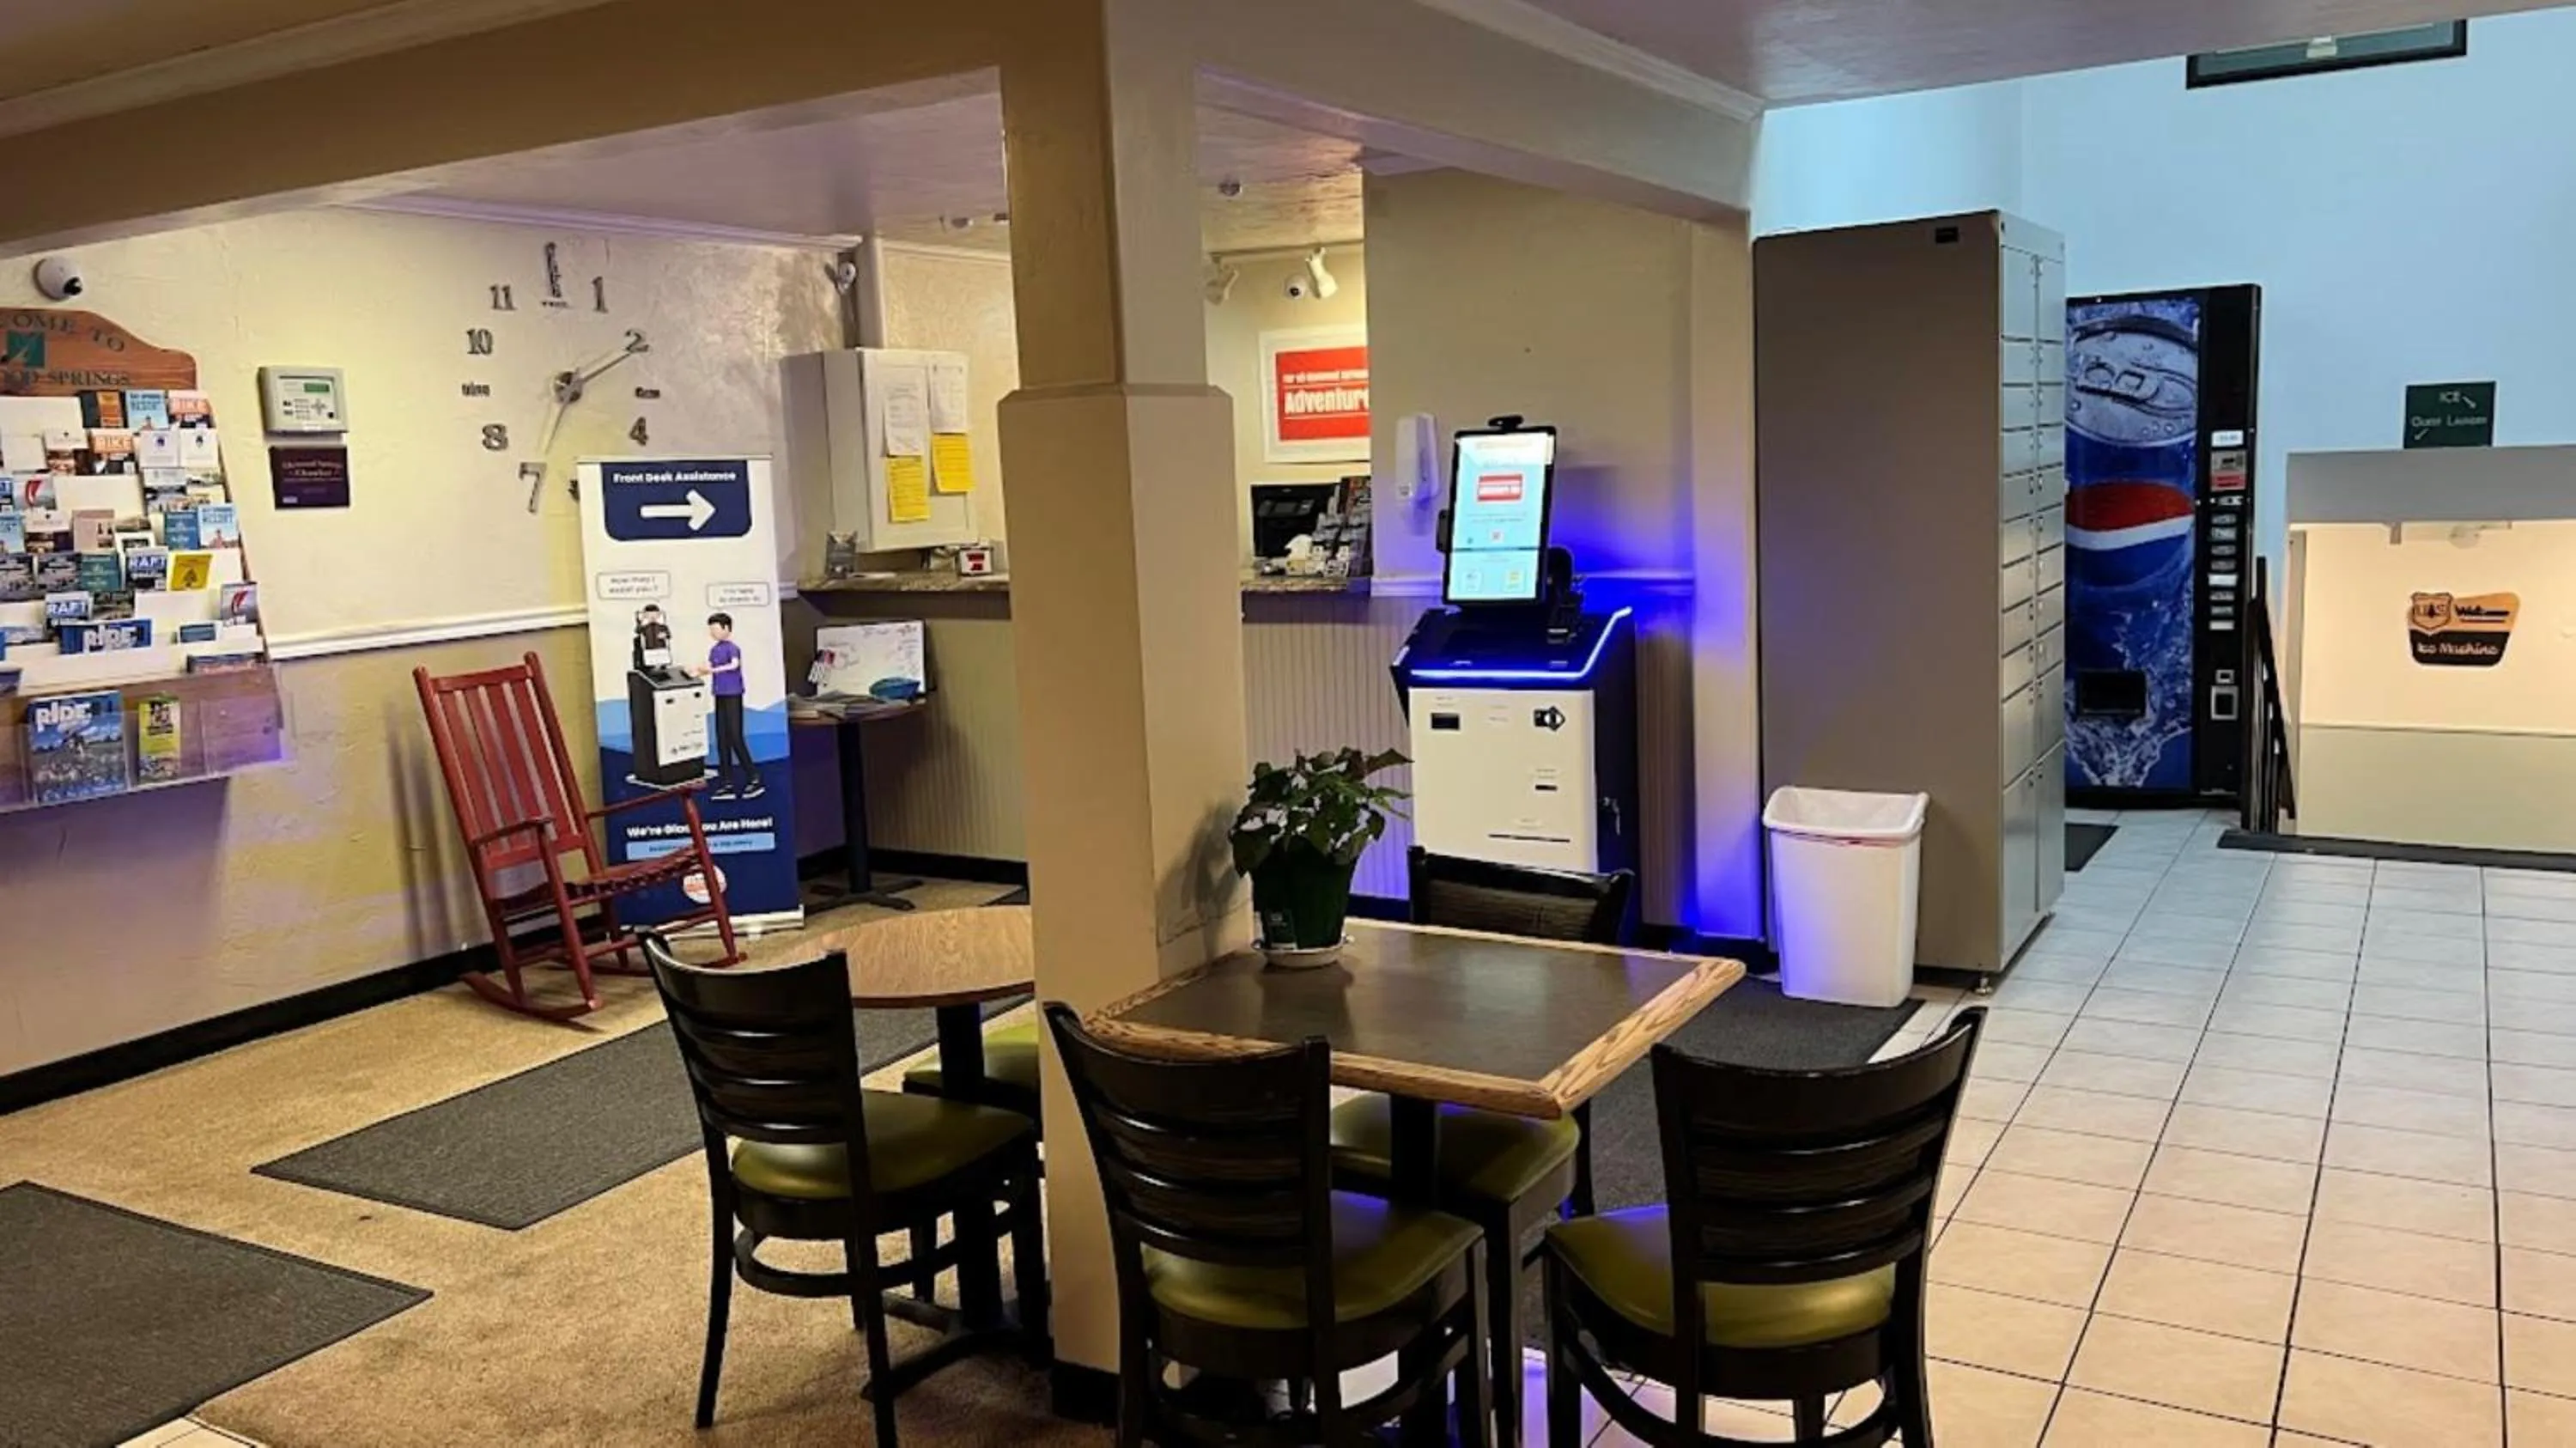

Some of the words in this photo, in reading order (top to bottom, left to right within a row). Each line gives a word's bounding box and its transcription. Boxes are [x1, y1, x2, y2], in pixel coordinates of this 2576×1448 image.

[489, 284, 517, 311] 11
[91, 325, 126, 353] TO
[466, 329, 493, 355] 10
[624, 329, 649, 353] 2
[2439, 391, 2461, 404] ICE
[482, 423, 508, 451] 8
[629, 417, 648, 446] 4
[519, 462, 546, 513] 7
[613, 472, 643, 484] Front
[645, 472, 672, 483] Desk
[675, 470, 736, 482] Assistance
[83, 623, 137, 653] RIDE
[35, 702, 91, 732] RIDE
[719, 819, 739, 830] Are
[741, 817, 773, 829] Here!
